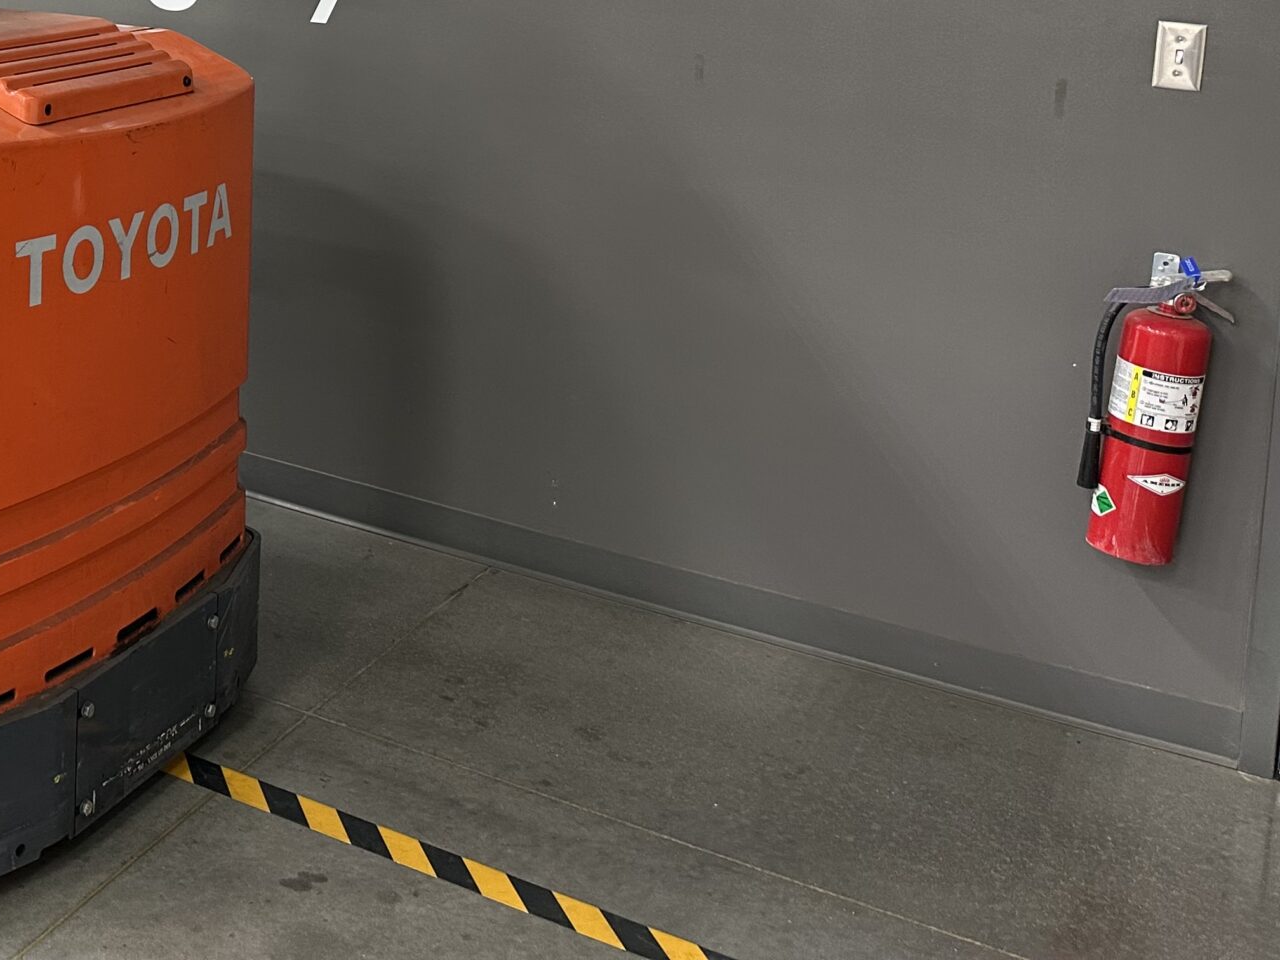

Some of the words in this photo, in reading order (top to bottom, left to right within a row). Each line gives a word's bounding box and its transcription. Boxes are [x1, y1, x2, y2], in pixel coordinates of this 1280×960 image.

[15, 182, 233, 308] TOYOTA
[1133, 372, 1139, 381] A
[1151, 371, 1201, 385] INSTRUCTIONS
[1130, 390, 1136, 399] B
[1127, 407, 1133, 417] C
